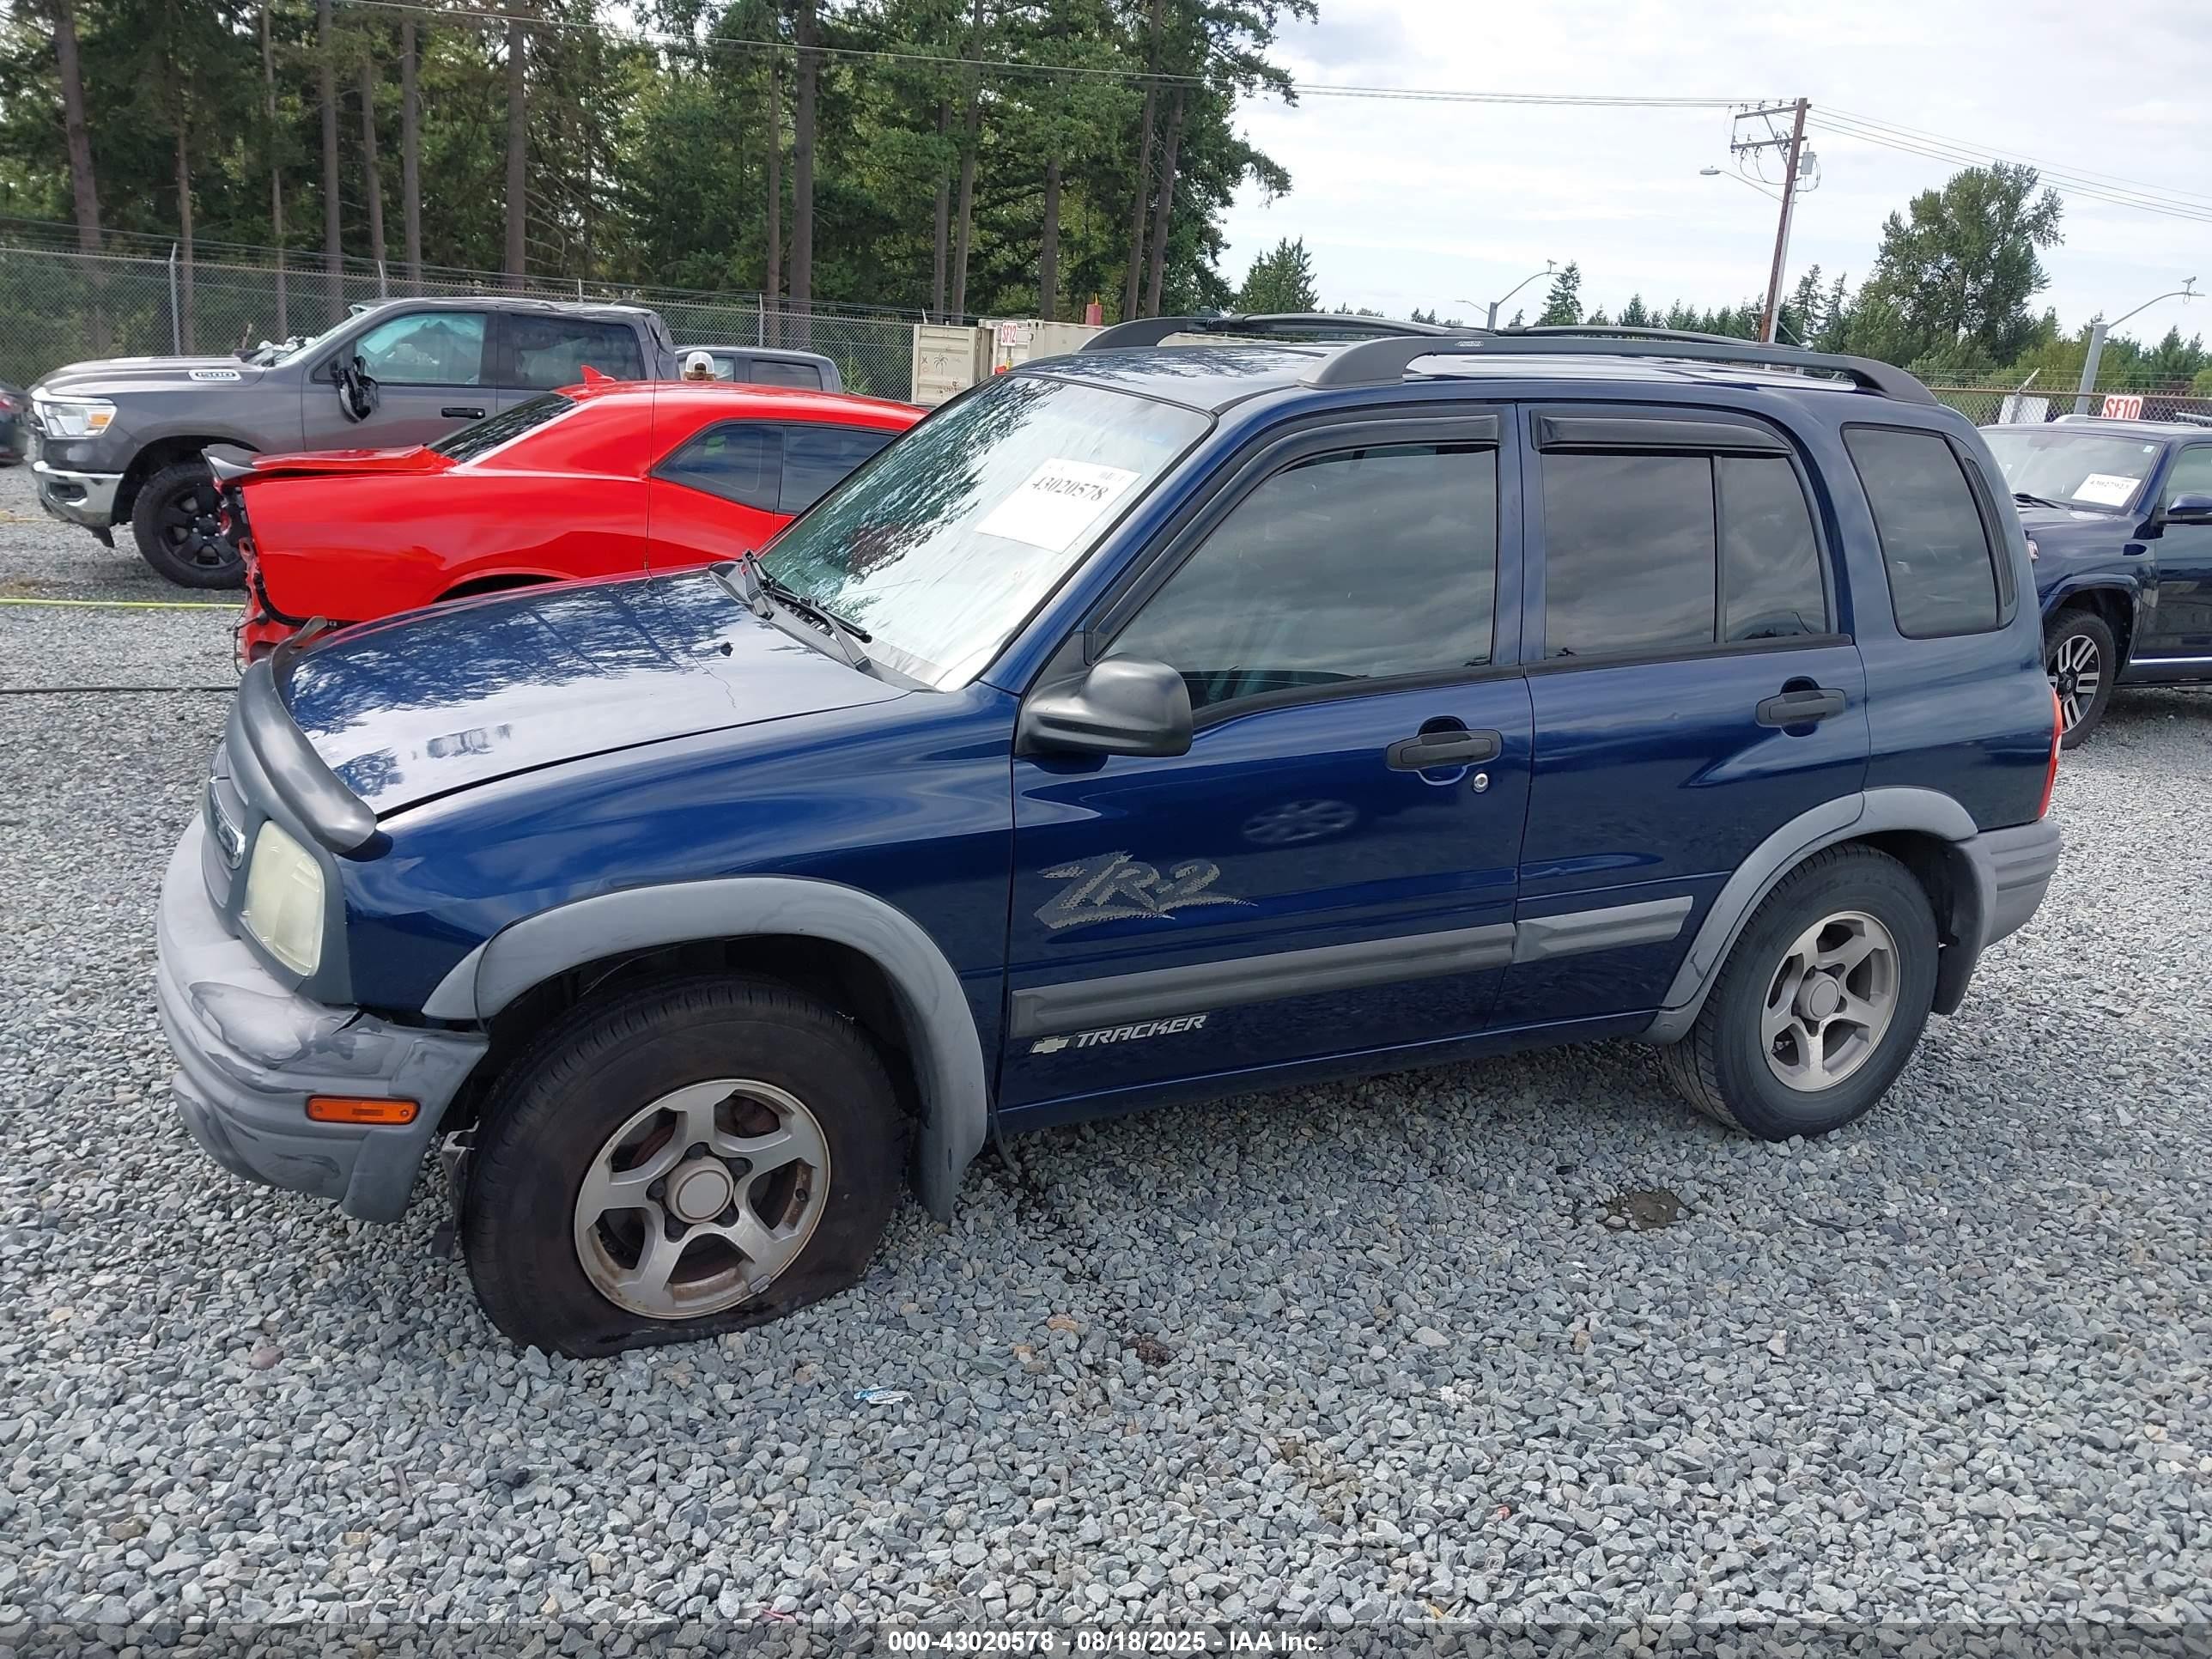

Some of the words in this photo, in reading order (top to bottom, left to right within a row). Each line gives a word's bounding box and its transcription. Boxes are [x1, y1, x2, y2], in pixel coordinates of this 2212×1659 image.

[1002, 325, 1017, 343] SF12
[2103, 398, 2140, 420] SF10
[1030, 476, 1109, 501] 43020578
[1076, 1015, 1207, 1048] TRACKER
